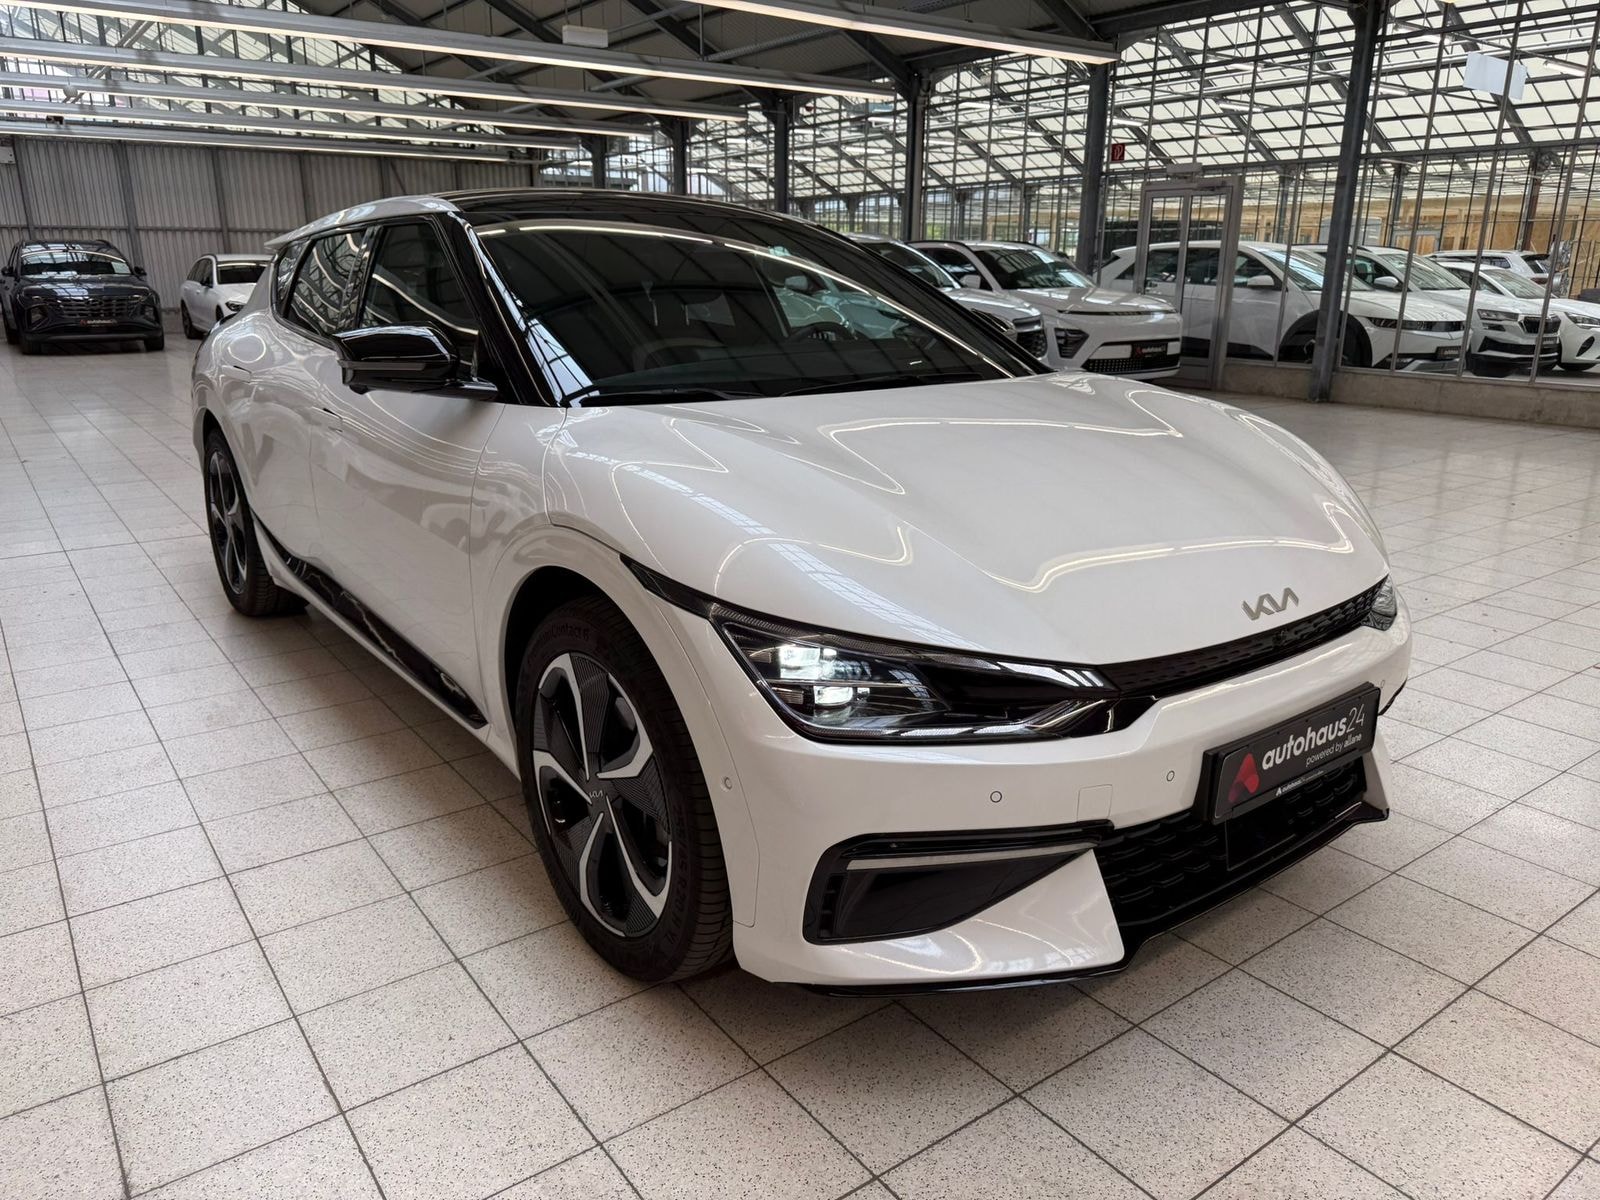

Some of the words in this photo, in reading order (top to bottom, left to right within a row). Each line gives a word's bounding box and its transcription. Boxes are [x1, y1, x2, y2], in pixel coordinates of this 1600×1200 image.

[1241, 587, 1300, 621] KIA
[1262, 703, 1365, 770] autohaus24
[1305, 745, 1334, 767] powered
[1335, 741, 1344, 753] by
[1343, 733, 1362, 748] allane
